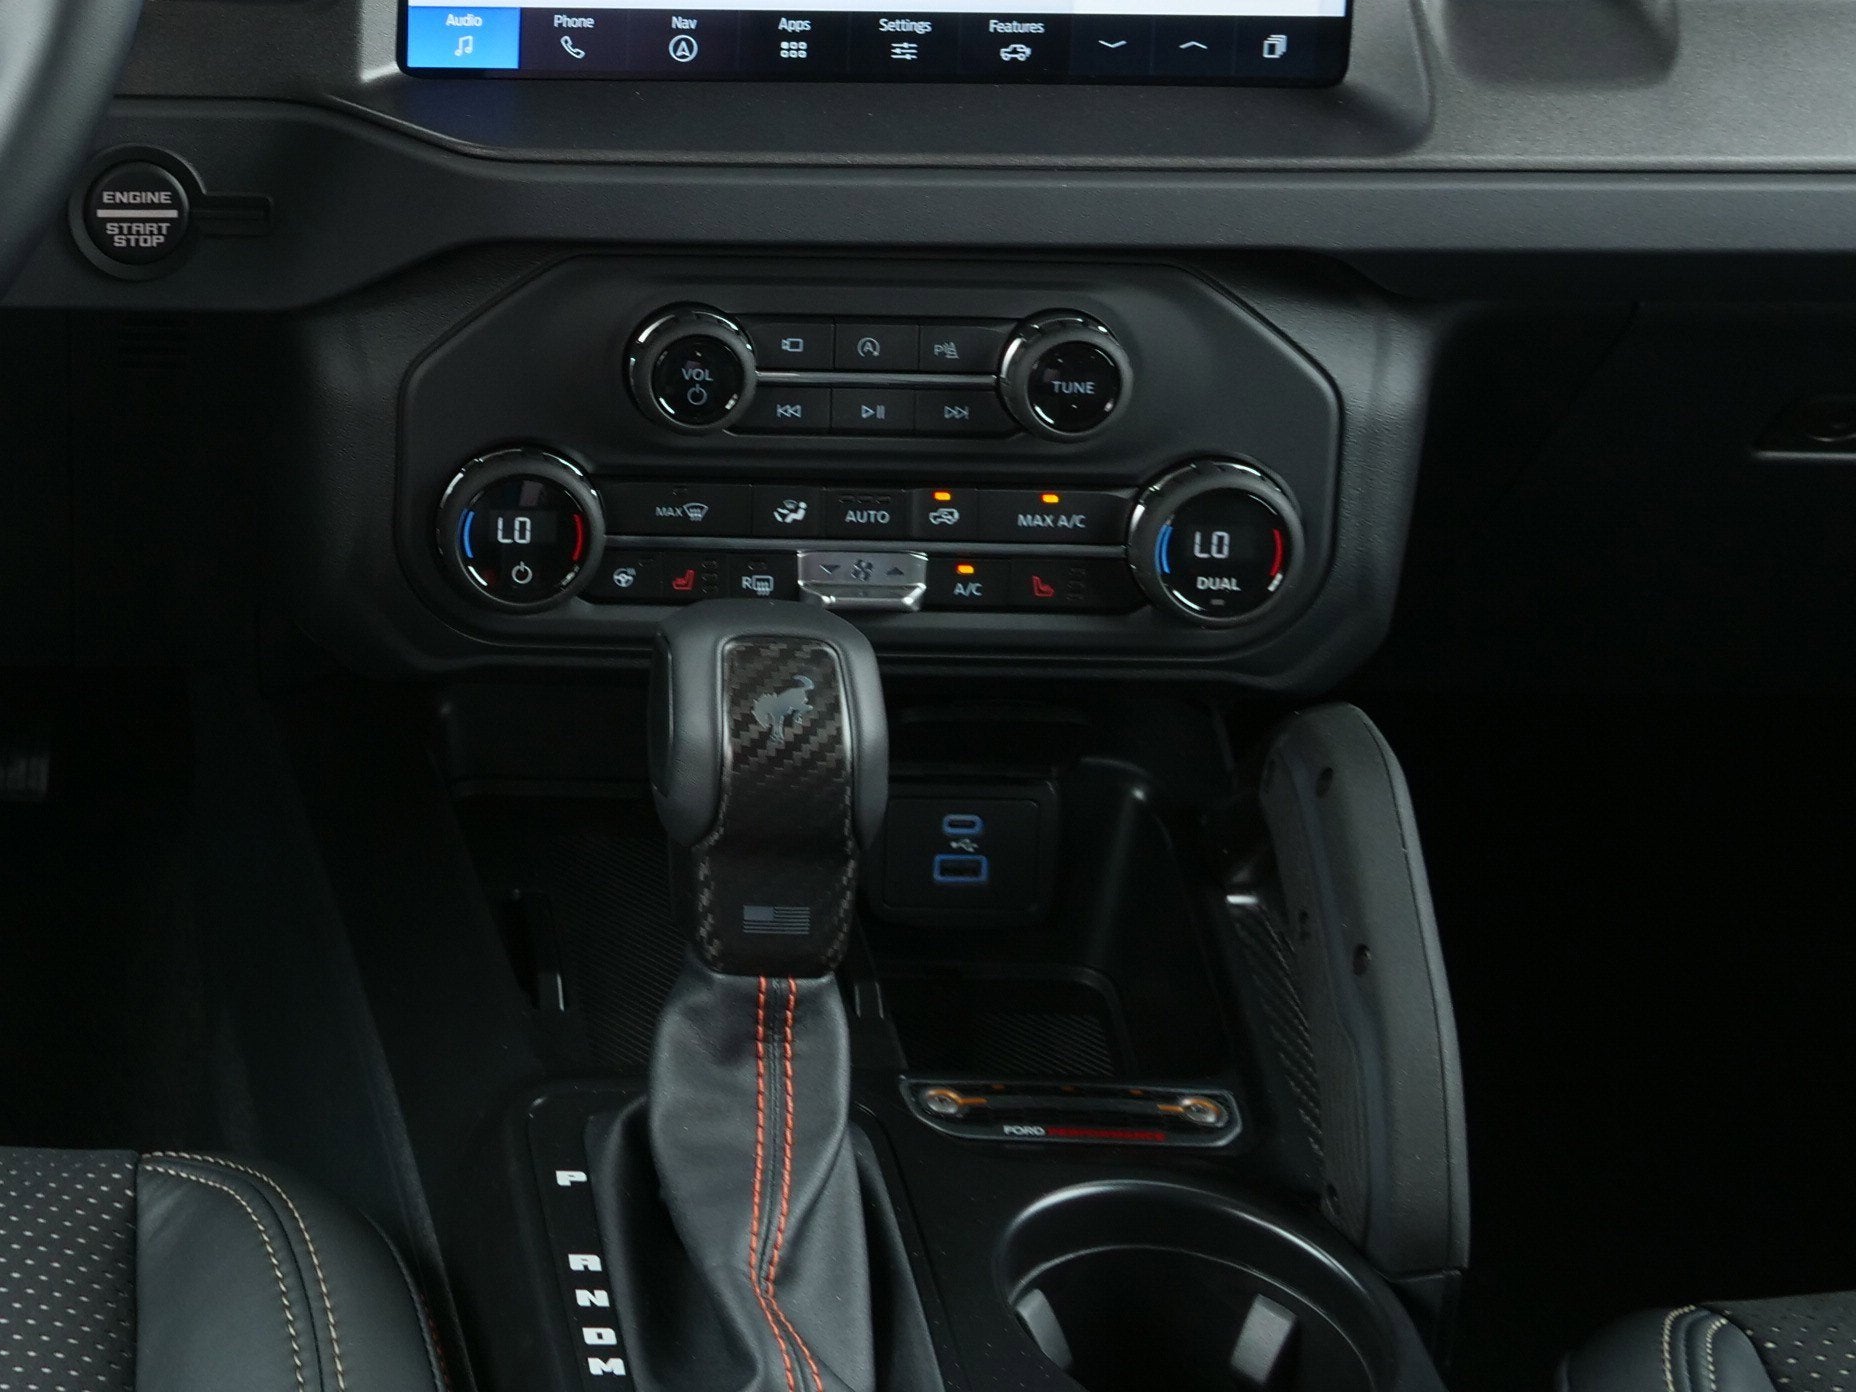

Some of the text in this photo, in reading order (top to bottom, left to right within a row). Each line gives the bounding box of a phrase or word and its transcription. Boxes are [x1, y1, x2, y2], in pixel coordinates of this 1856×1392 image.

[445, 13, 483, 28] Audio
[553, 15, 595, 29] Phone
[671, 16, 697, 30] Nav
[778, 18, 812, 34] Apps
[878, 18, 933, 35] Settings
[989, 18, 1045, 34] Features
[102, 191, 172, 204] ENGINE
[105, 222, 171, 235] START
[113, 235, 165, 247] STOP
[681, 368, 714, 382] VOL
[1052, 380, 1095, 395] TUNE
[655, 506, 683, 518] MAX
[845, 510, 890, 524] AUTO
[1017, 513, 1086, 529] MAX A/C
[497, 516, 532, 545] LO
[1194, 531, 1230, 559] LO
[953, 582, 982, 597] A/C
[1196, 577, 1240, 592] DUAL
[555, 1170, 588, 1187] P
[568, 1253, 603, 1272] R
[575, 1289, 610, 1307] N
[582, 1327, 618, 1345] D
[587, 1357, 627, 1376] M
